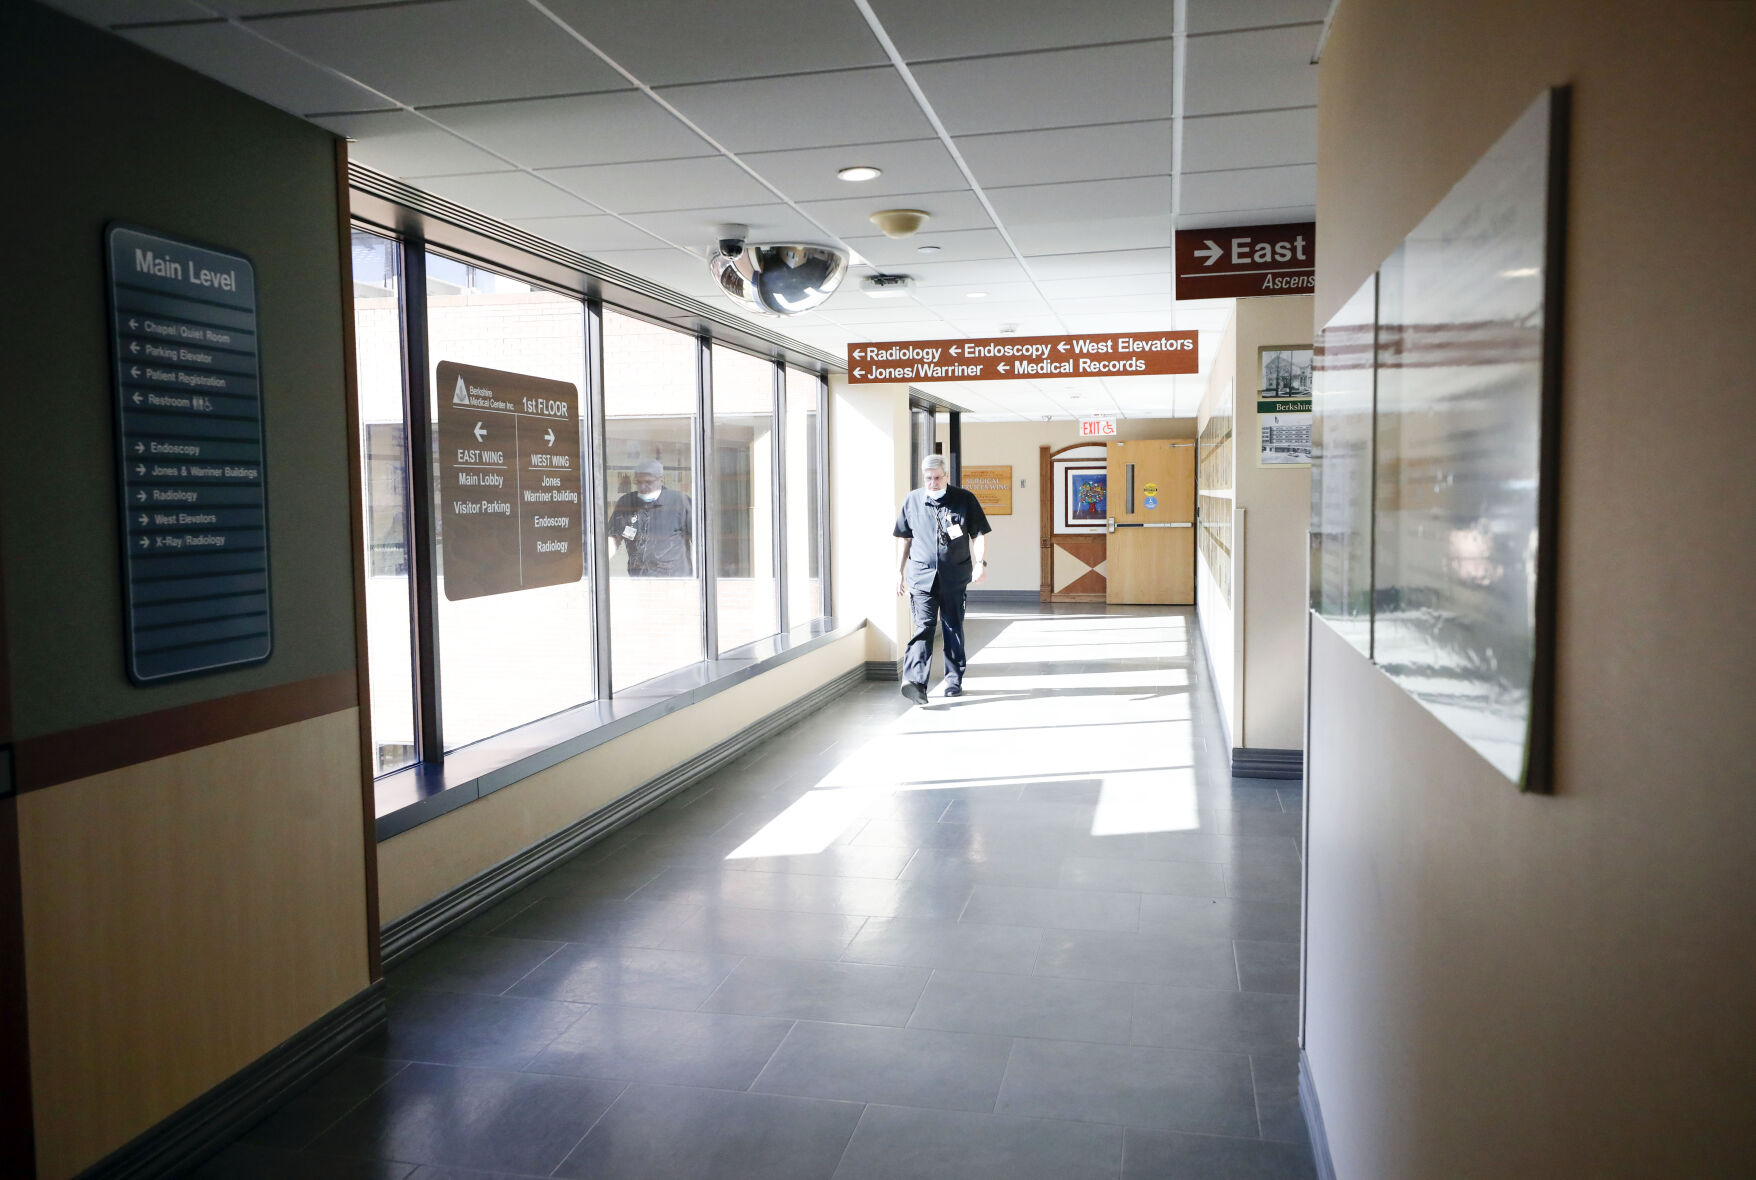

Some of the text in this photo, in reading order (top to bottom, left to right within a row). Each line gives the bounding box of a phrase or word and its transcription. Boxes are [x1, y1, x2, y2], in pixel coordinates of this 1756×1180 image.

[1231, 235, 1306, 264] East
[135, 248, 236, 292] Main Level
[206, 331, 231, 344] Room
[145, 344, 212, 363] Parking Elevator
[866, 337, 1194, 363] Radiology Endoscopy West Elevators
[867, 357, 1146, 379] Jones/Warriner Medical Records
[146, 368, 226, 388] Patient Registration
[470, 385, 493, 398] Berkshire
[148, 393, 190, 408] Restroom
[470, 396, 490, 407] Medical
[490, 399, 506, 409] Center
[523, 396, 568, 417] 1st FLOOR
[1083, 421, 1100, 435] EXIT
[150, 442, 200, 456] Endoscopy
[458, 449, 504, 464] EAST WING
[531, 454, 569, 467] WEST WING
[152, 465, 178, 476] Jones
[181, 466, 188, 476] &
[224, 467, 258, 479] Buildings
[458, 473, 503, 488] Main Lobby
[541, 475, 561, 487] Jones
[153, 490, 198, 502] Radiology
[524, 490, 578, 504] Warriner Building
[454, 501, 511, 516] Visitor Parking
[154, 513, 217, 525] West Elevators
[534, 515, 569, 529] Endoscopy
[186, 535, 225, 546] Radiology
[537, 540, 569, 553] Radiology
